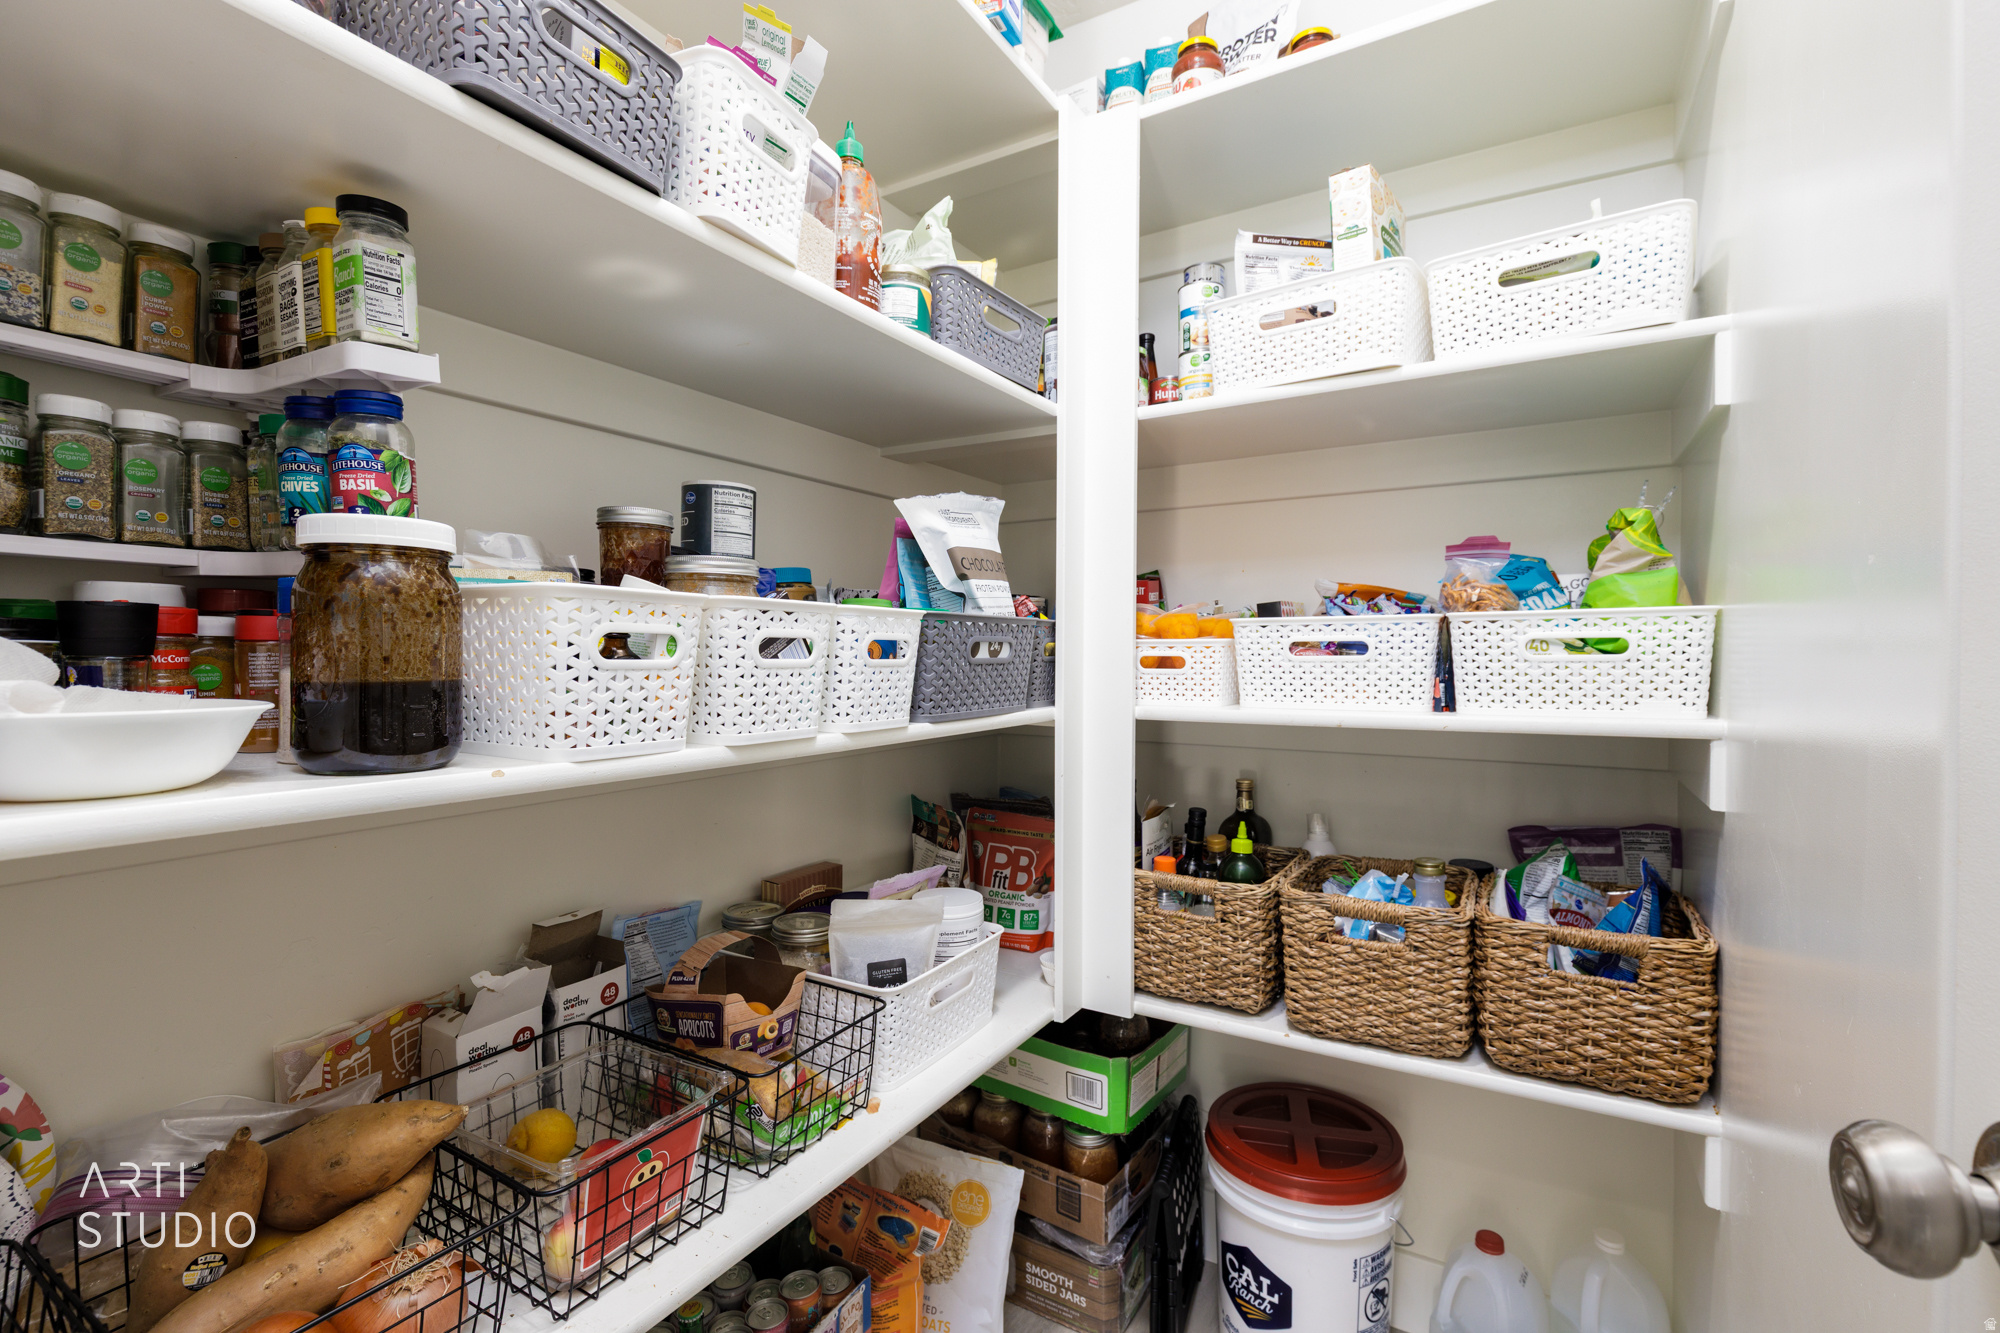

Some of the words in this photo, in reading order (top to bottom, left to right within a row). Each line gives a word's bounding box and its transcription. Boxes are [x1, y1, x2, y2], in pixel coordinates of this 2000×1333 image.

[762, 27, 786, 46] original
[757, 57, 769, 67] RUE
[1281, 238, 1292, 246] Way
[1299, 239, 1325, 247] CRUNCH
[67, 252, 99, 266] organic
[362, 249, 385, 261] Nutrition
[386, 255, 401, 266] Facts
[334, 262, 355, 287] Ranch
[67, 282, 91, 292] GROUND
[143, 280, 171, 293] organic
[365, 281, 389, 293] Calories
[396, 287, 402, 296] 0
[335, 287, 355, 300] SEASONING
[144, 295, 167, 305] CURRY
[279, 298, 298, 313] BAGEL
[338, 296, 350, 306] BLEND
[144, 301, 174, 313] POWDER
[280, 308, 298, 323] SESAME
[56, 453, 89, 462] organic
[332, 459, 385, 471] LITEHOUSE
[58, 470, 96, 479] OREGANO
[127, 469, 156, 478] organic
[203, 477, 229, 485] organic
[280, 481, 319, 492] CHIVES
[339, 478, 379, 491] BASIL
[128, 485, 165, 494] ROSEMARY
[205, 491, 229, 499] RUBBED
[714, 490, 740, 498] Nutrition
[293, 508, 300, 516] 2
[714, 507, 735, 515] Calories
[943, 515, 977, 524] INGREDIENTS
[975, 583, 997, 593] PROTEIN
[1528, 638, 1550, 652] 40
[989, 826, 1029, 837] AWARD-WINNING
[1029, 831, 1045, 839] TASTE
[1146, 847, 1154, 857] Air
[984, 842, 1037, 893] PB
[992, 870, 1009, 891] fit
[988, 889, 1026, 902] ORGANIC
[997, 898, 1015, 906] PEANUT
[1014, 900, 1036, 908] POWDER
[1023, 913, 1037, 922] 87%
[965, 928, 978, 936] Facts
[872, 968, 891, 976] GLUTEN
[603, 986, 616, 998] 48
[563, 994, 580, 1006] deal
[563, 998, 590, 1011] worthy
[675, 1010, 703, 1020] SENSATIONALLY
[703, 1012, 716, 1021] SWEET!
[678, 1018, 716, 1040] APRICOTS
[516, 1030, 531, 1044] 48
[468, 1041, 488, 1056] deal
[756, 1042, 774, 1056] APRICOTS
[483, 1059, 499, 1069] Spoons
[956, 1201, 983, 1214] DEGREE
[1088, 1266, 1099, 1277] 12
[1369, 1259, 1386, 1274] AVISO
[1025, 1261, 1074, 1290] SMOOTH
[1226, 1251, 1279, 1305] CAL
[1025, 1273, 1057, 1294] SIDED
[1059, 1288, 1087, 1308] JARS
[1228, 1271, 1274, 1315] Ranch
[922, 1316, 951, 1333] OATS
